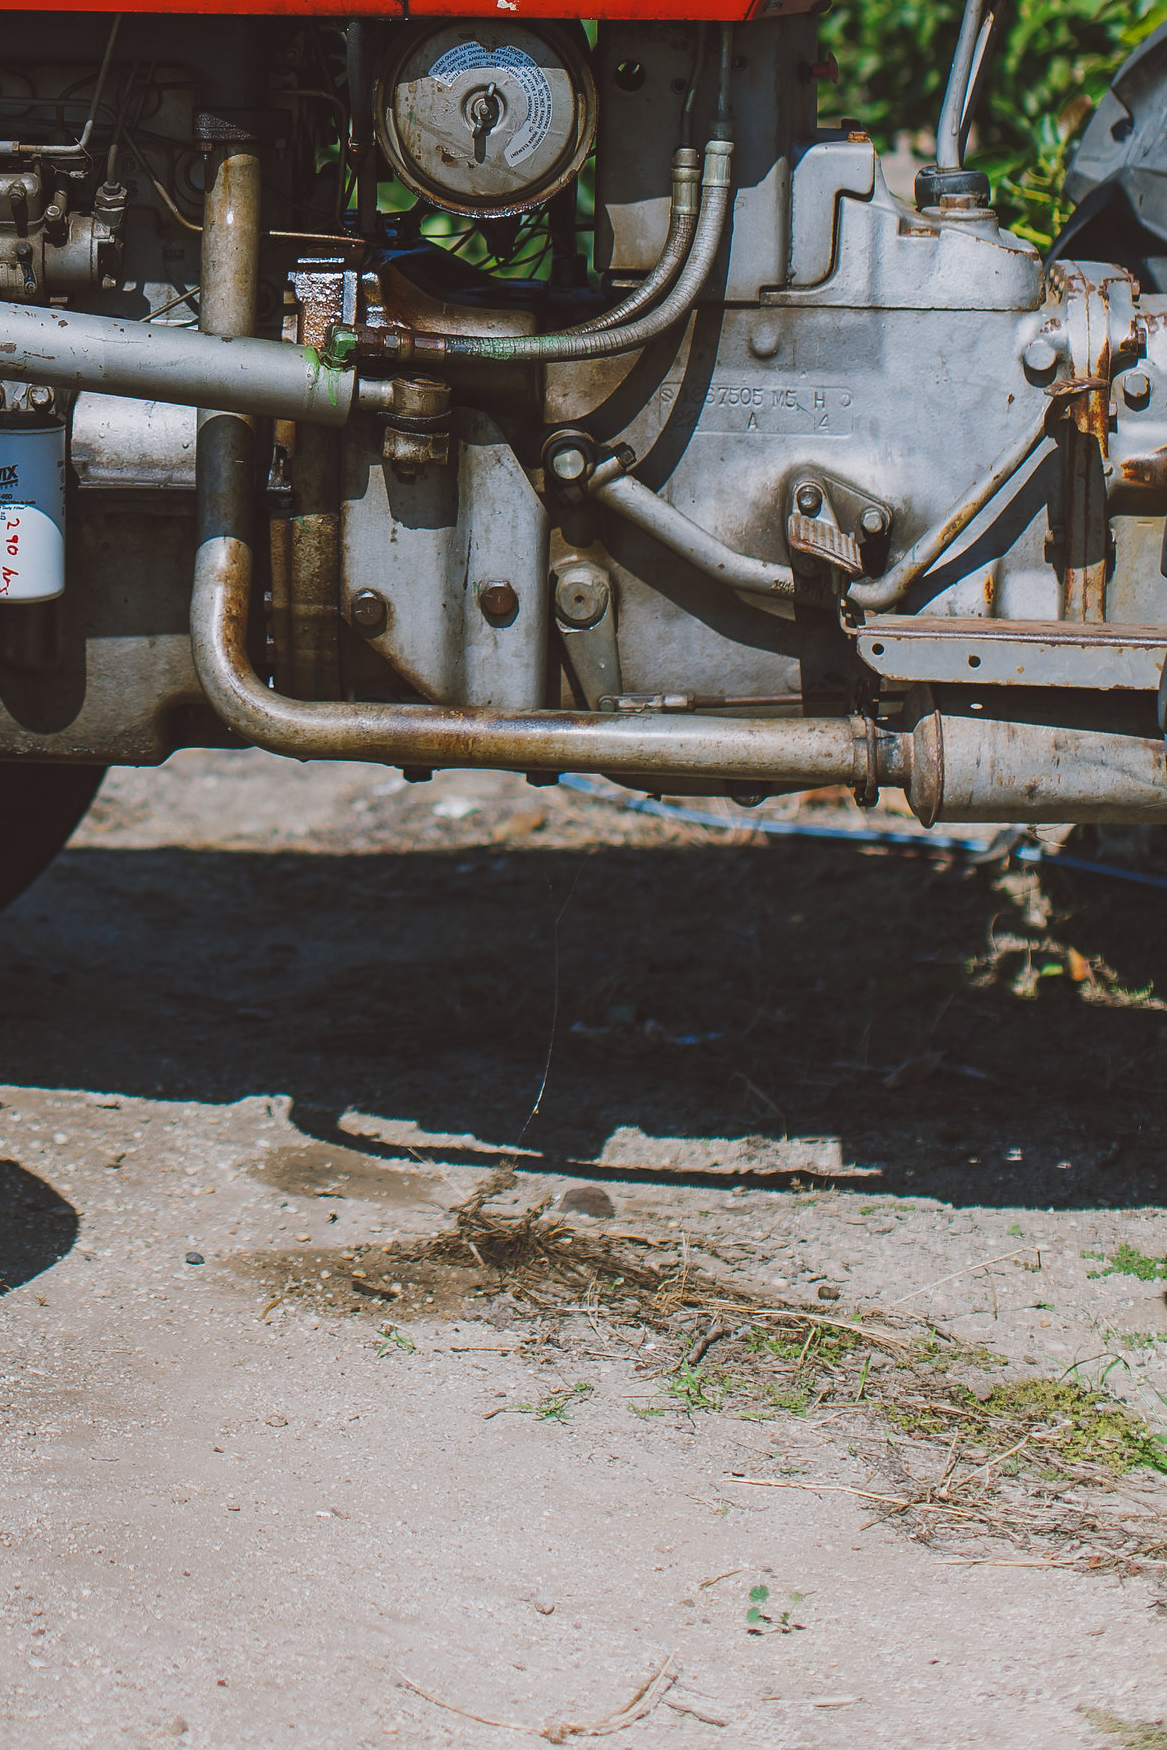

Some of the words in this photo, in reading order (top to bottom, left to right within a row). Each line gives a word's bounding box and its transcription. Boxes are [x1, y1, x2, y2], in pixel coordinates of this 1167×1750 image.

[432, 59, 444, 72] CLEAN
[444, 50, 457, 60] OUTER
[457, 58, 466, 66] FOR
[438, 66, 447, 75] AND
[814, 391, 826, 409] H
[748, 412, 759, 431] A
